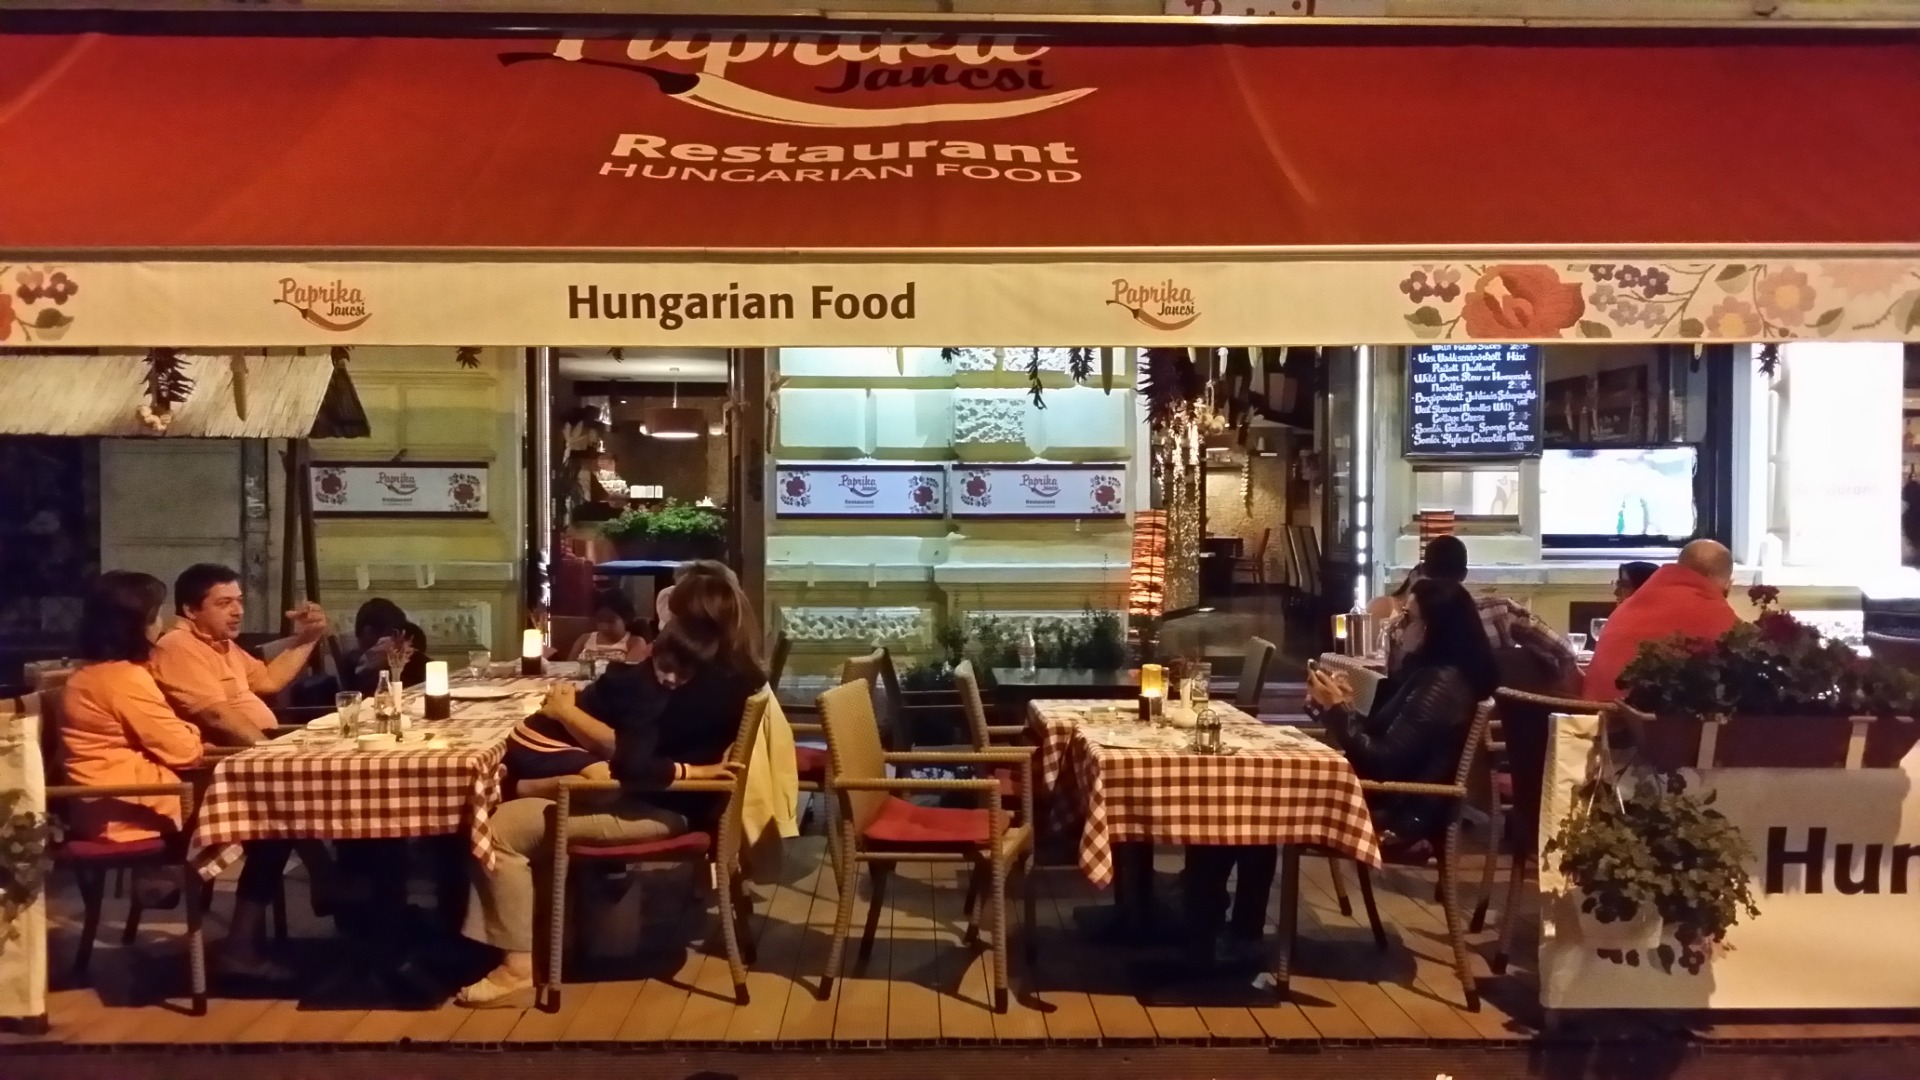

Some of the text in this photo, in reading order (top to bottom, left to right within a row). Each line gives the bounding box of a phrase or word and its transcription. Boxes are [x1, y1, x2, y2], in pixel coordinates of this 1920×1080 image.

[814, 60, 1053, 93] Jancsi
[611, 133, 1078, 164] Restaurant
[599, 161, 1082, 183] HUNGARIAN FOOD
[278, 277, 366, 309] Paprika
[1112, 278, 1196, 308] Paprika
[326, 301, 366, 317] Jancsi
[568, 281, 915, 331] Hungarian Food
[1157, 301, 1195, 317] Jancsi
[1431, 383, 1464, 392] Noodles
[1462, 403, 1491, 412] Noodles
[1461, 412, 1485, 422] Cheese
[1508, 420, 1529, 431] Cake
[1471, 431, 1507, 444] Chocolate
[1507, 431, 1535, 442] Mousse
[840, 474, 877, 488] Paprika
[1021, 474, 1058, 488] Paprika
